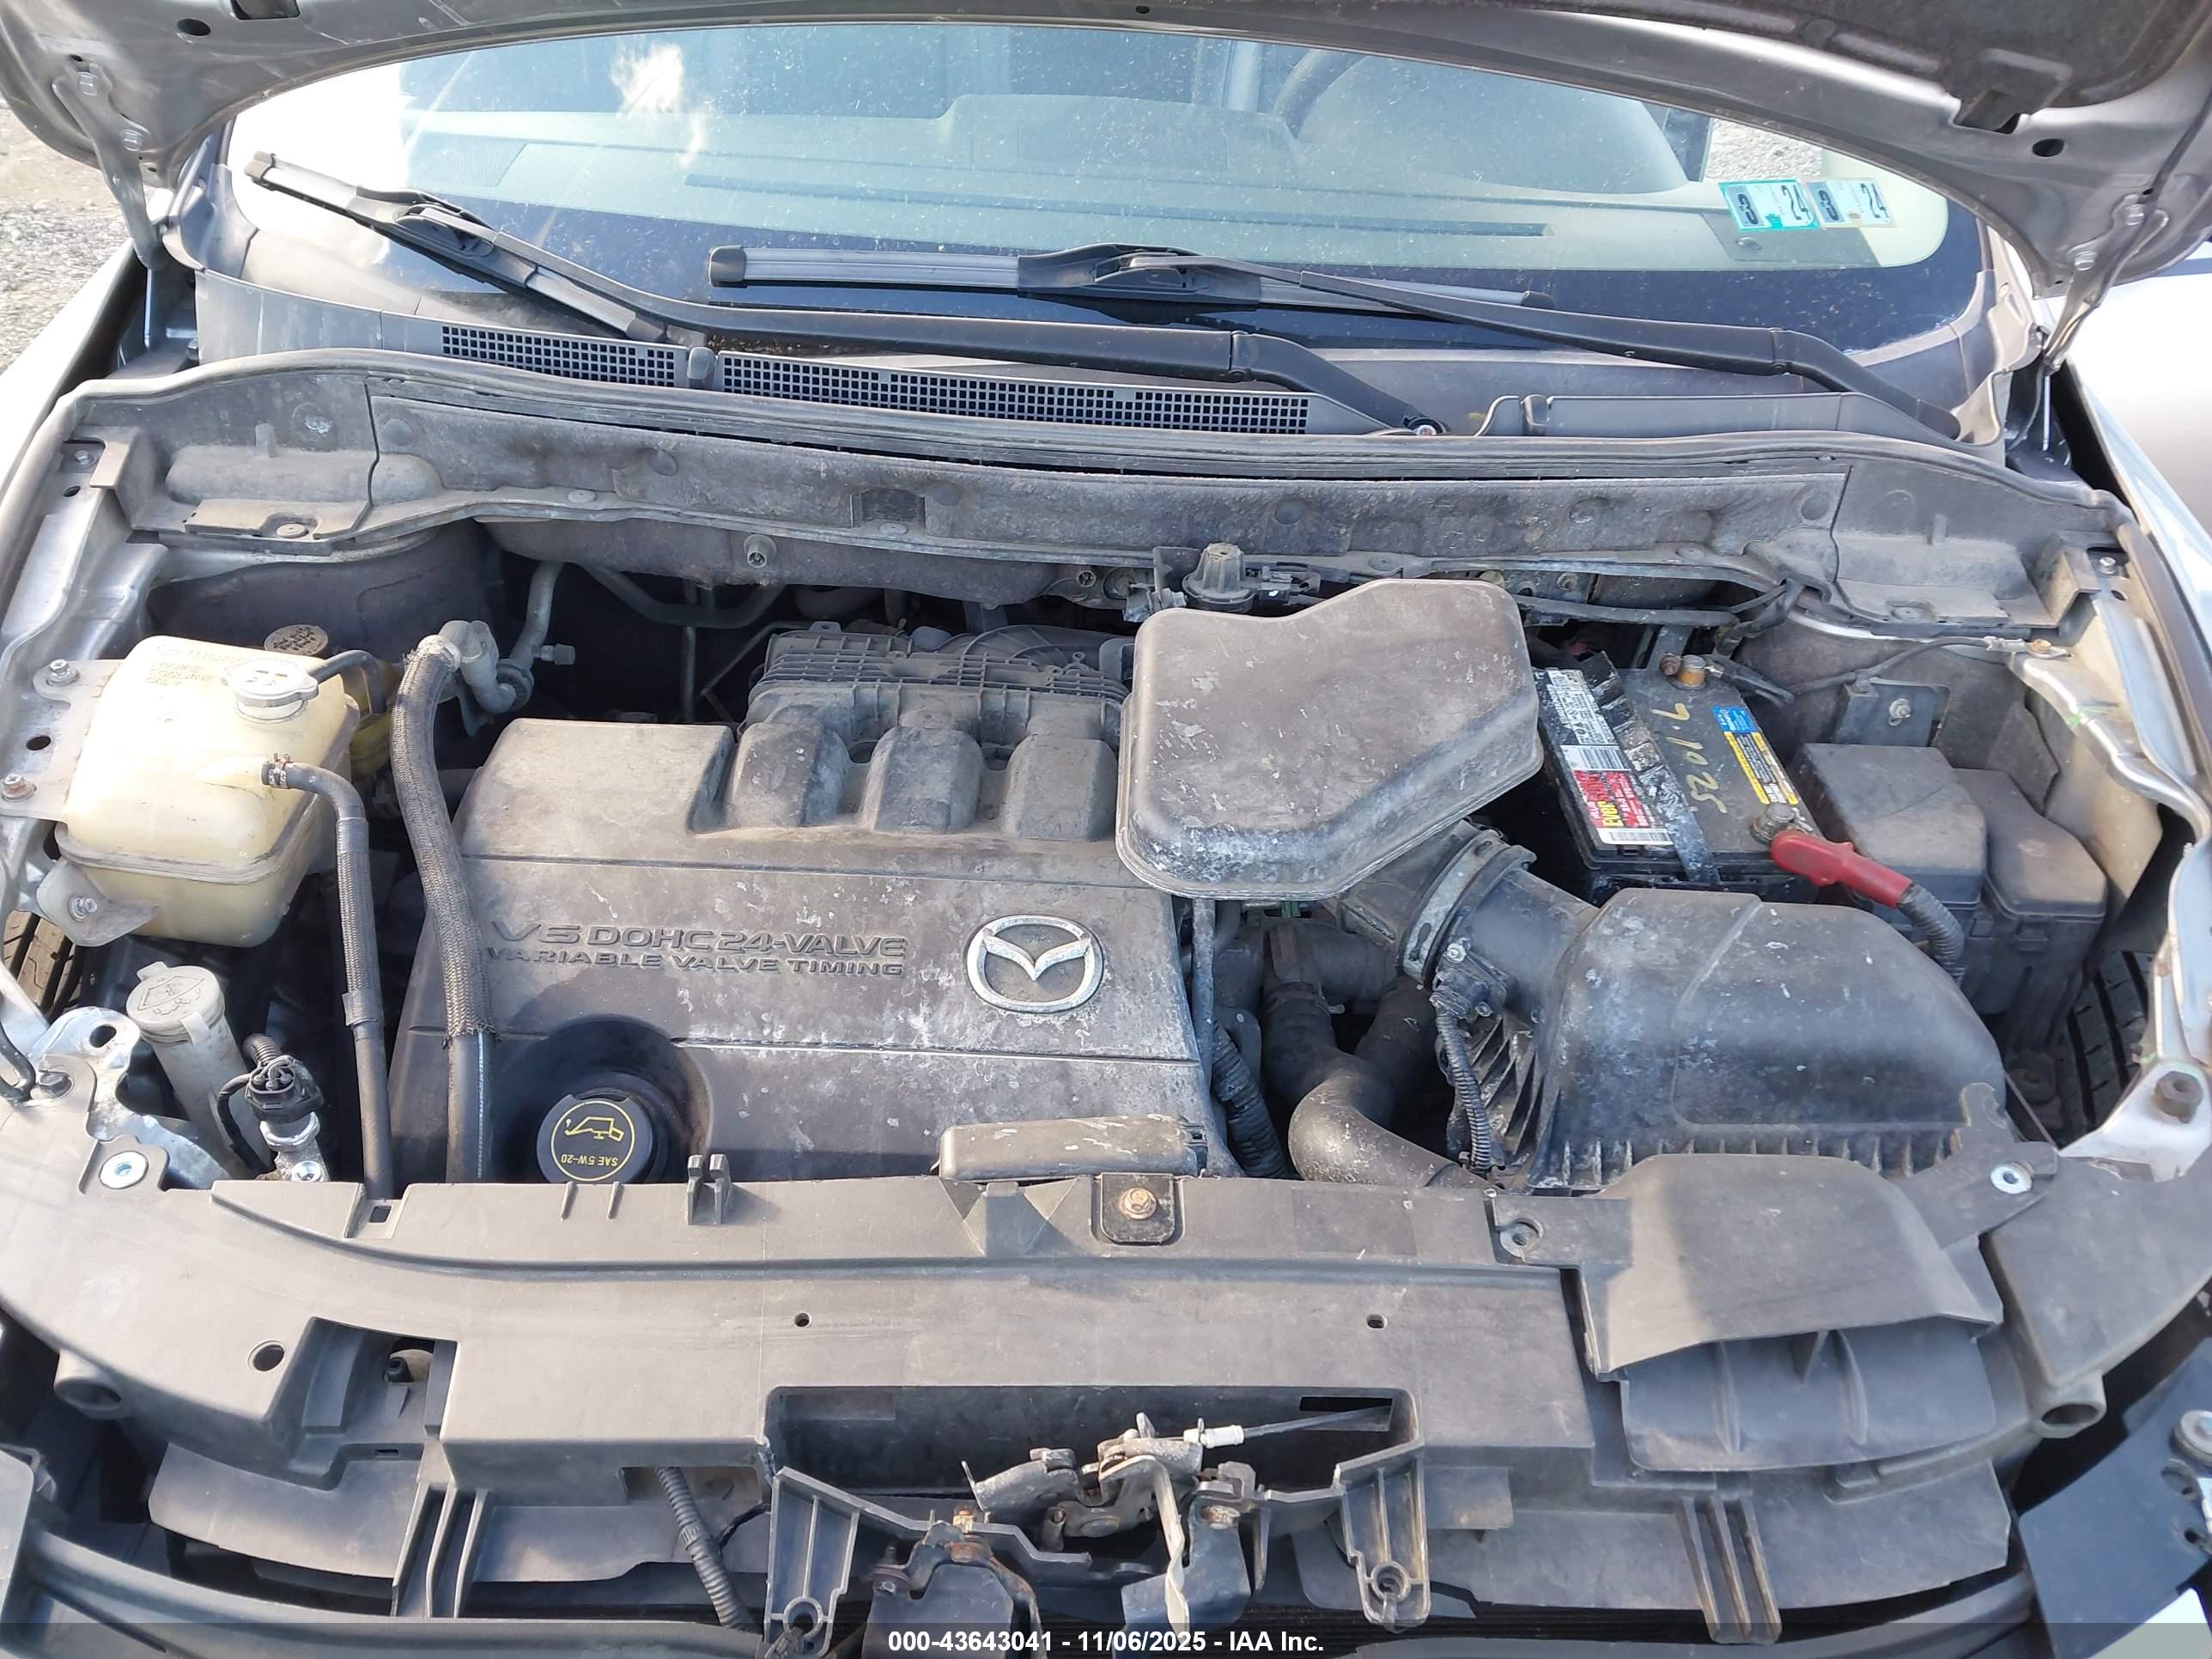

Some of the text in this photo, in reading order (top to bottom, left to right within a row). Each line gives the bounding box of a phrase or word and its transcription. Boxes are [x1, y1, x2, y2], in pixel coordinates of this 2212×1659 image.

[1781, 184, 1812, 221] 24
[1860, 182, 1890, 219] 24
[586, 926, 714, 951] DOHC
[716, 931, 908, 959] 24-VALVE
[487, 947, 904, 977] VARIABLE VALVE TIMING
[560, 1153, 619, 1167] SAE 5W-20
